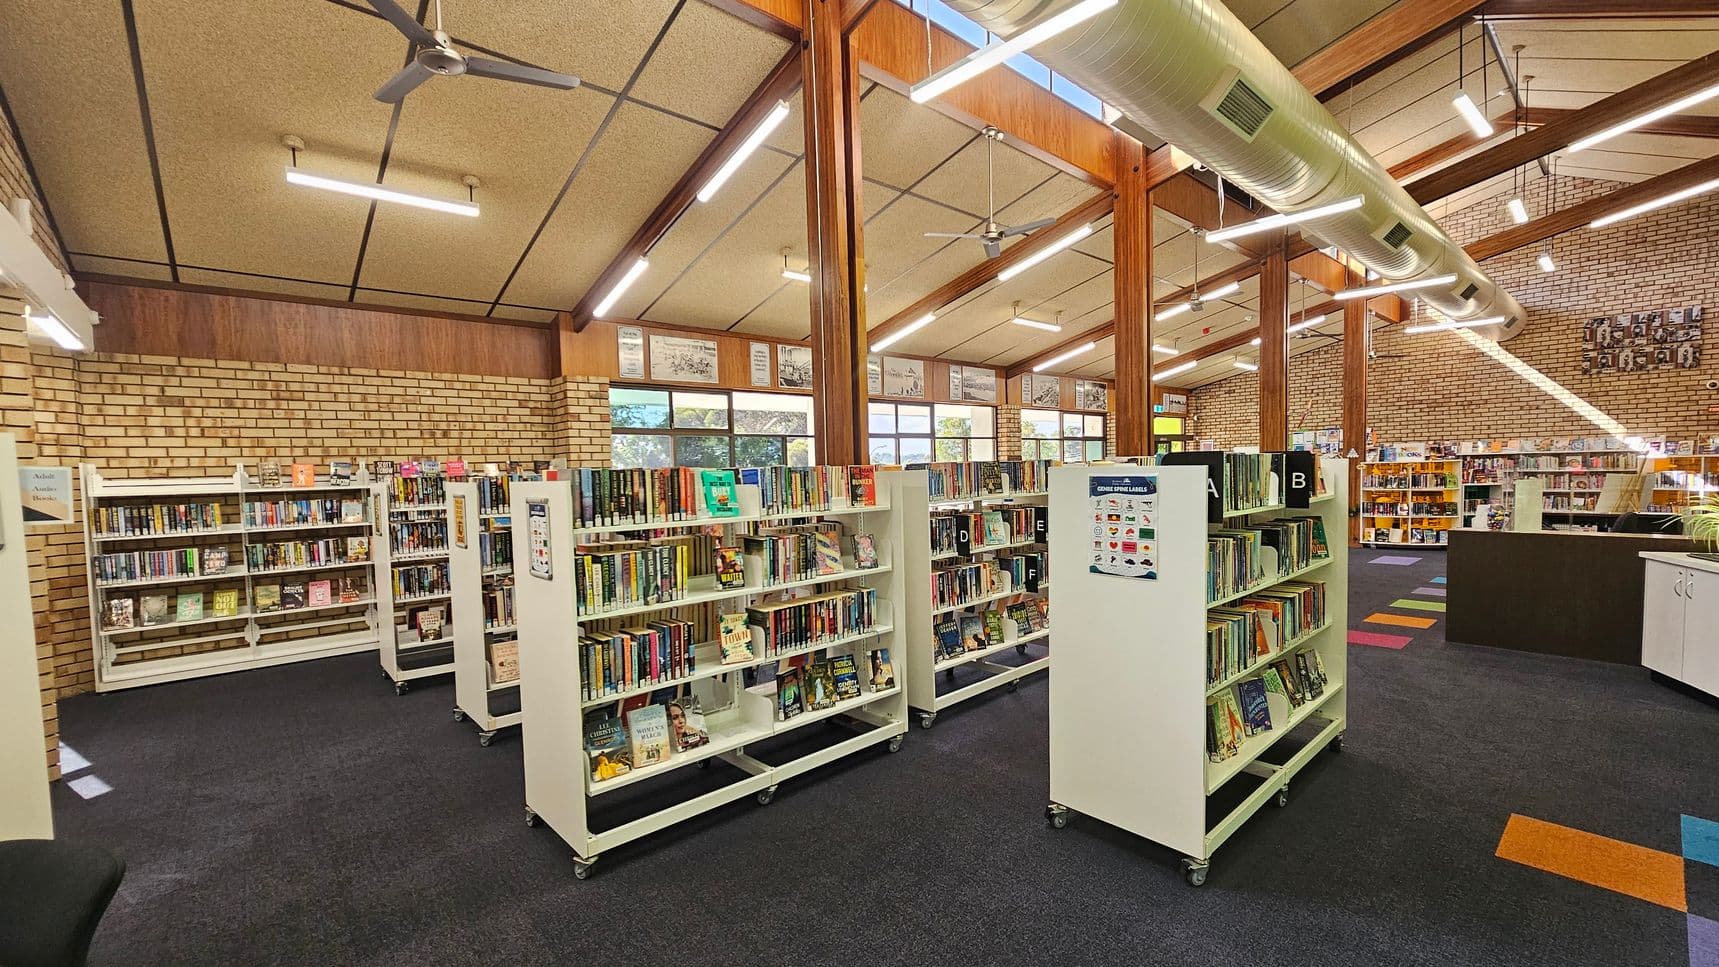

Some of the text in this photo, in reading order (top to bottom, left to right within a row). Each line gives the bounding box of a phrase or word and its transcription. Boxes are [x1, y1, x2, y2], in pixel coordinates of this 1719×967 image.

[1292, 472, 1306, 488] B
[1208, 477, 1219, 498] A
[1037, 520, 1044, 531] E
[960, 530, 969, 542] D
[721, 572, 743, 582] WAITER
[1029, 569, 1036, 580] F
[724, 630, 752, 645] TOWN
[590, 727, 620, 738] CHRISTINE
[641, 732, 662, 740] MARCH
